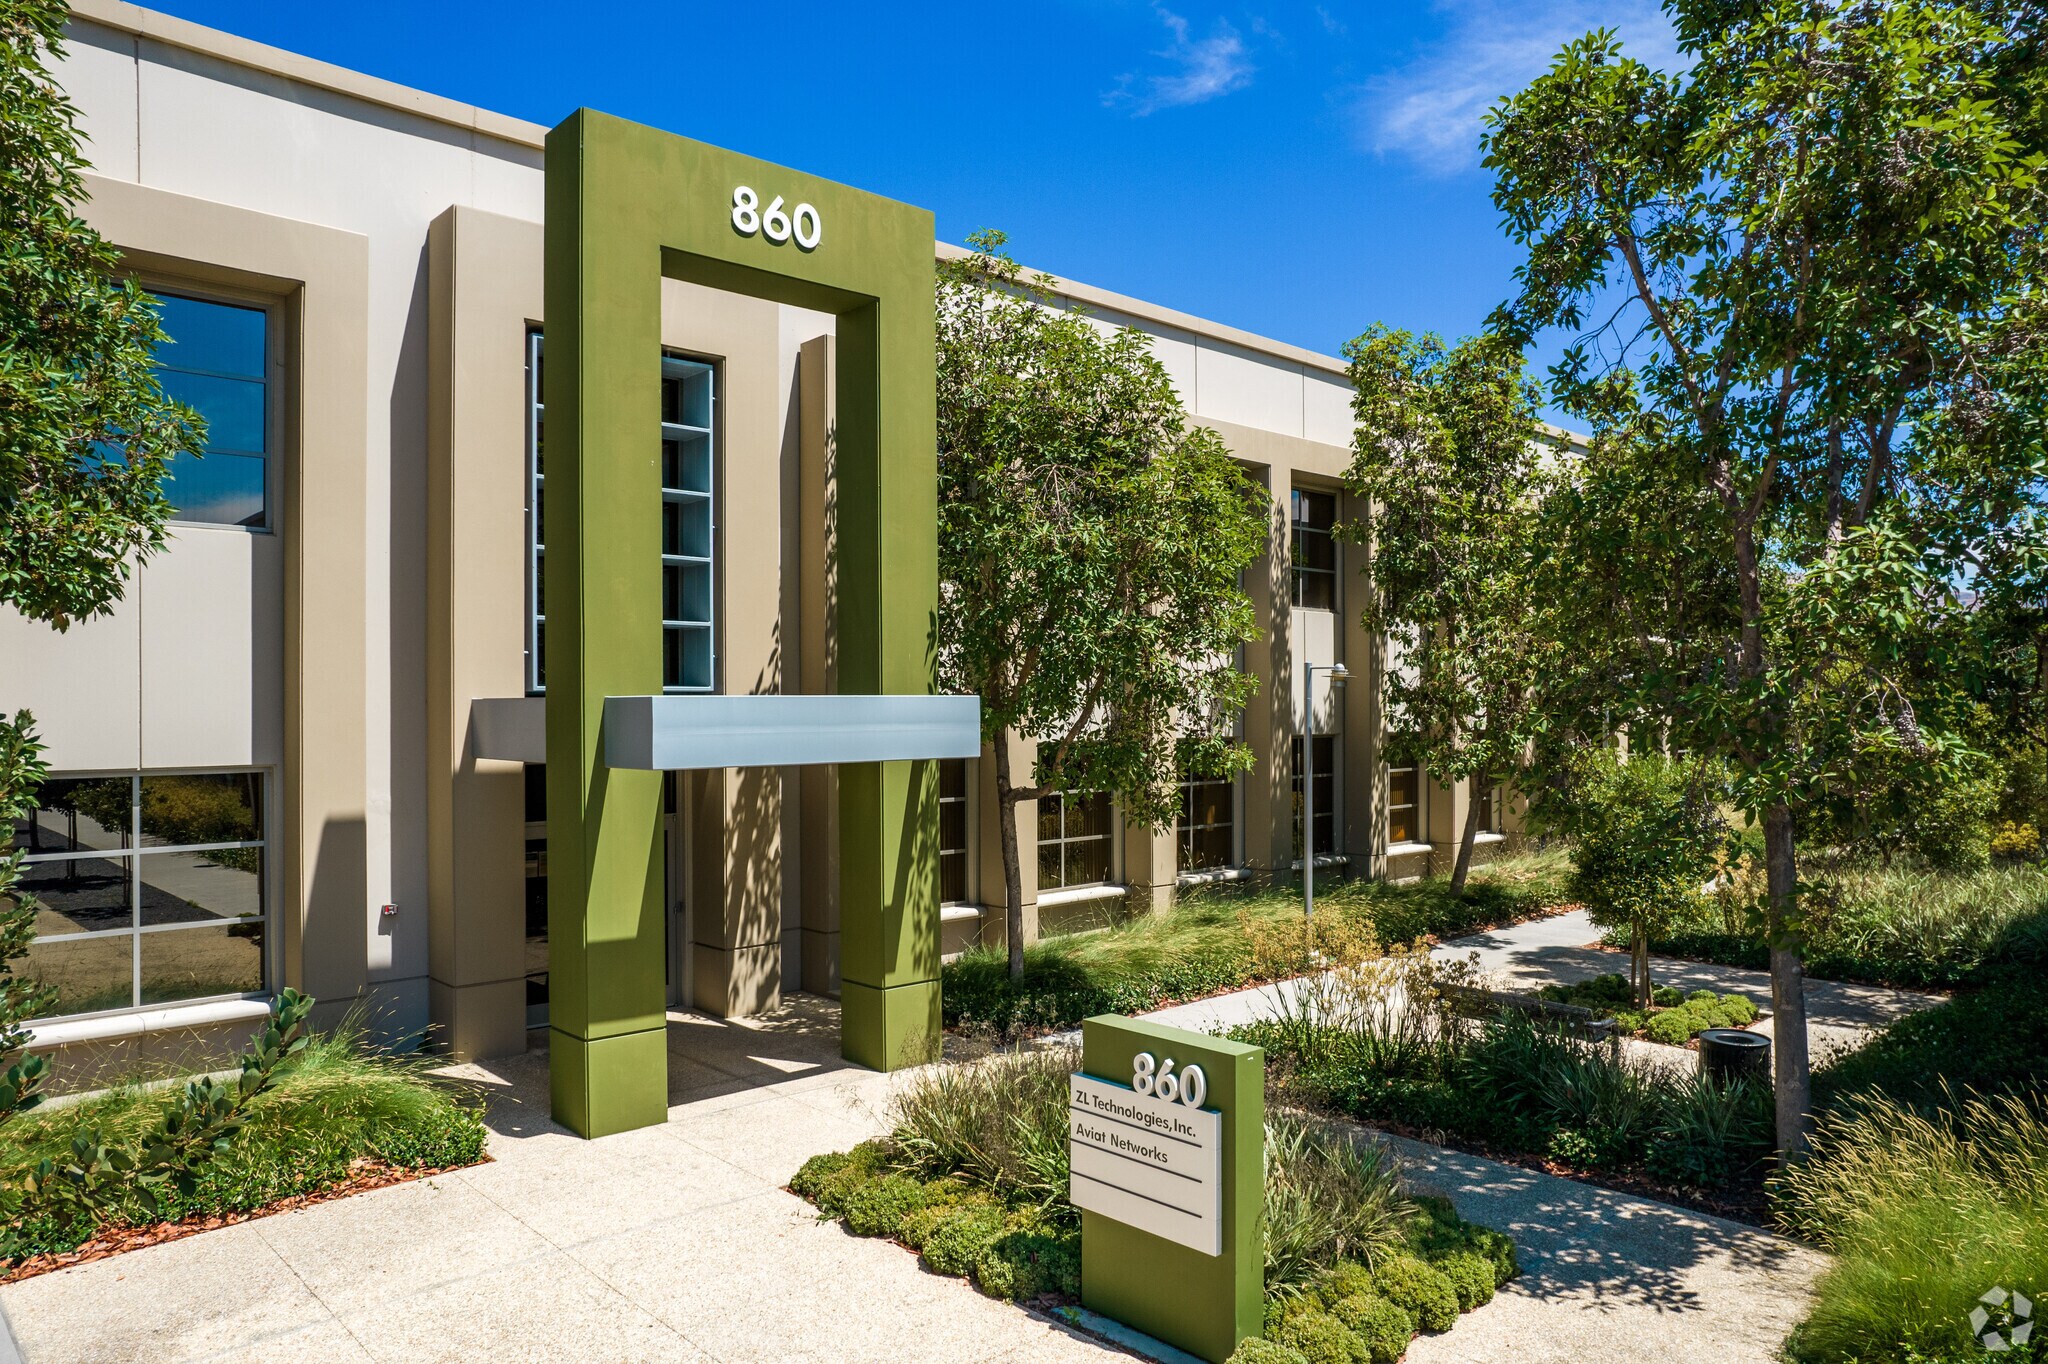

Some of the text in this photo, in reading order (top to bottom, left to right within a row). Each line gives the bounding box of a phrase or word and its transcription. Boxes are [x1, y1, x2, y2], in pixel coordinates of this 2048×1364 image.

[732, 185, 822, 249] 860
[1132, 1052, 1207, 1110] 860
[1075, 1090, 1197, 1138] ZL Technologies, Inc.
[1076, 1123, 1168, 1163] Aviat Networks
